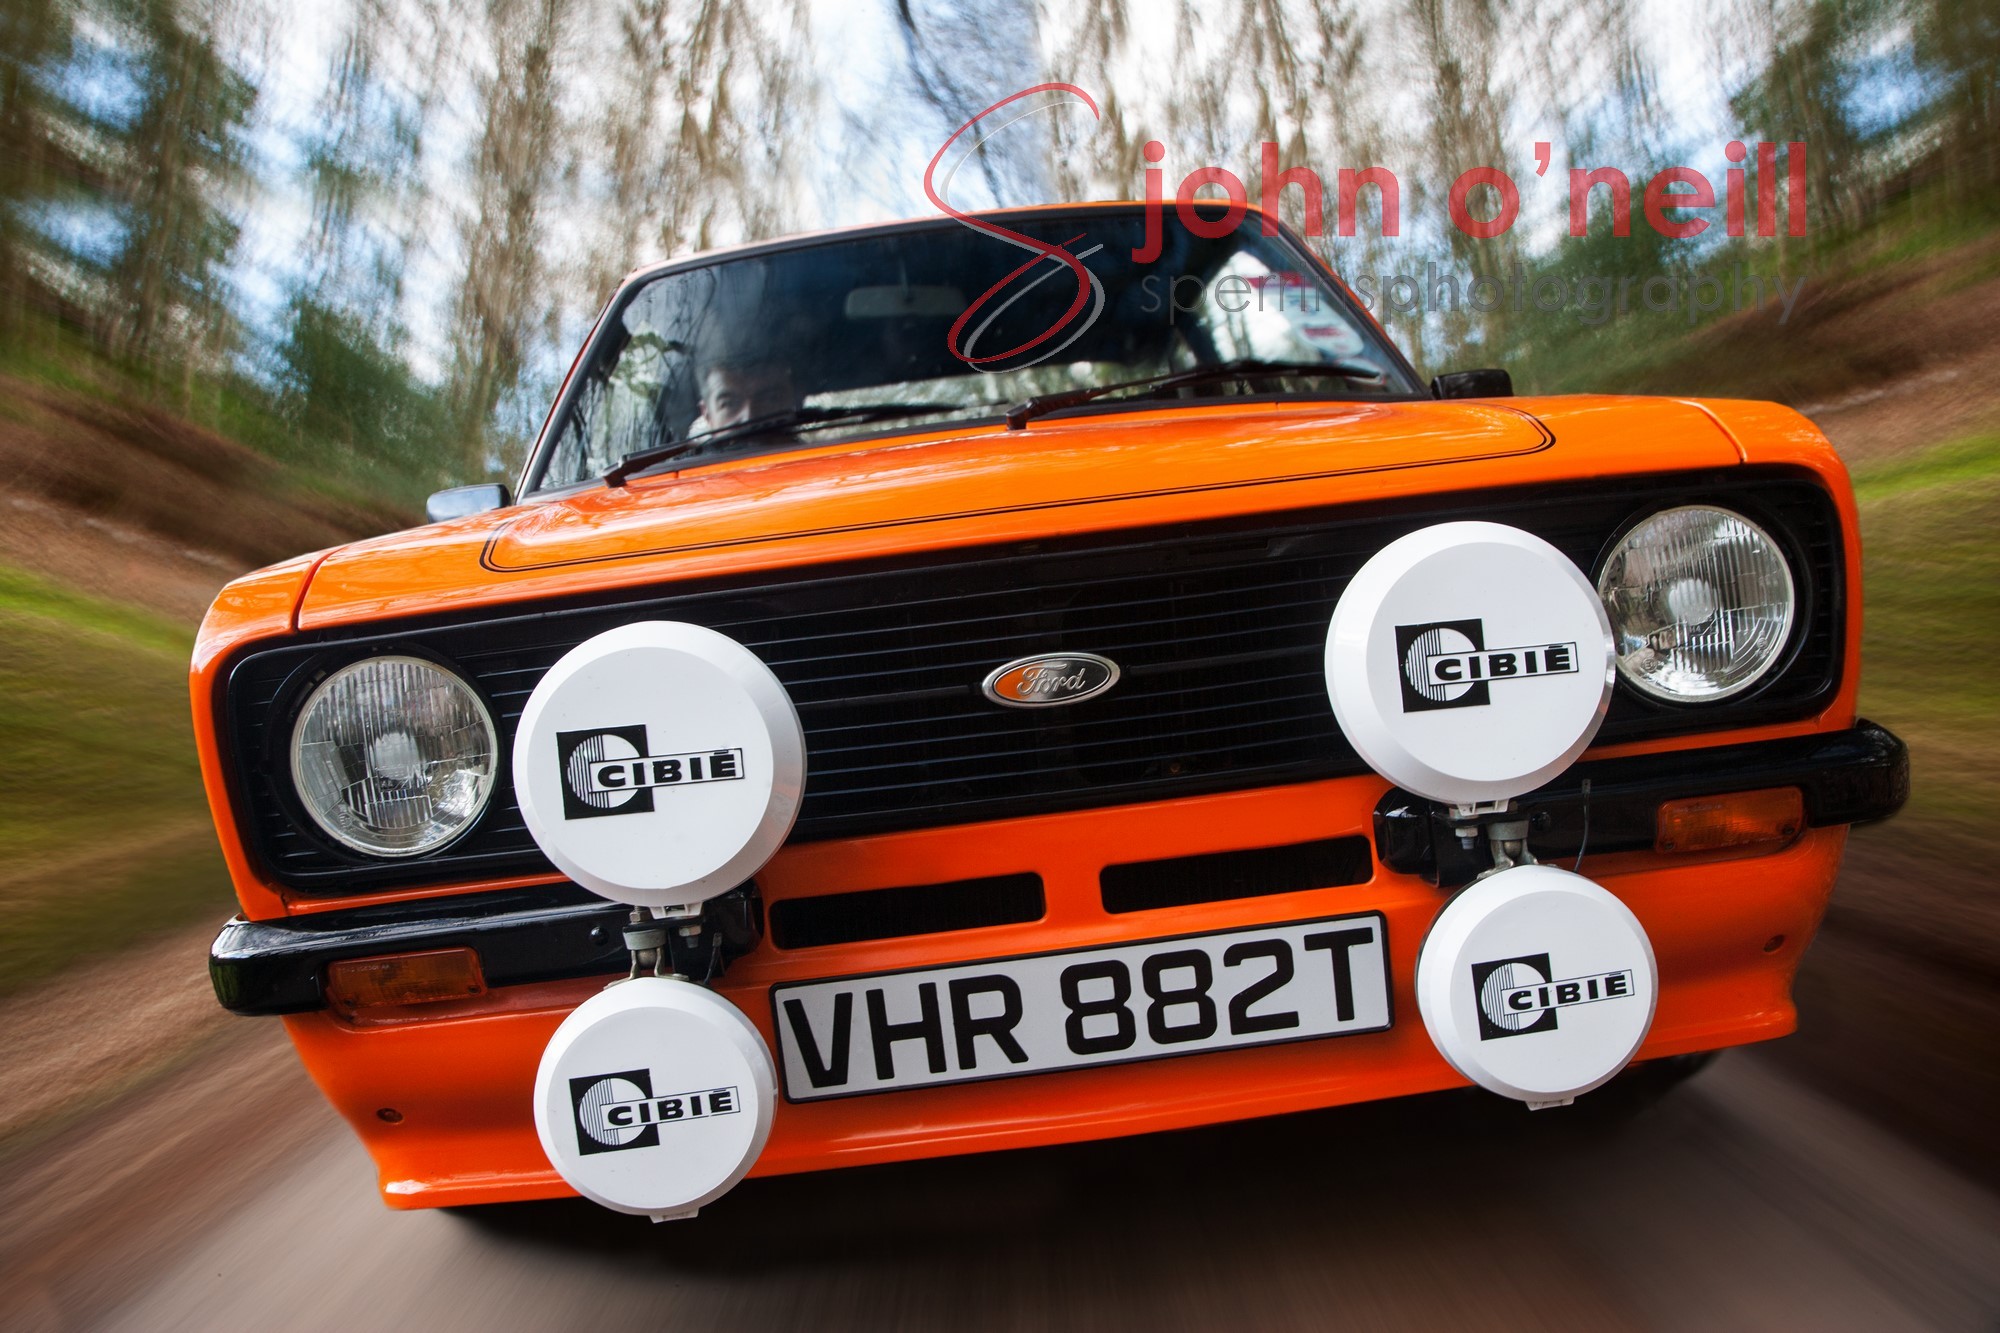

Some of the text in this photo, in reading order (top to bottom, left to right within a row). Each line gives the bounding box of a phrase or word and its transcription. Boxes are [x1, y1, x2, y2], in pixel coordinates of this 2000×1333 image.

[1016, 663, 1086, 696] Ford
[783, 926, 1374, 1088] VHR 882T
